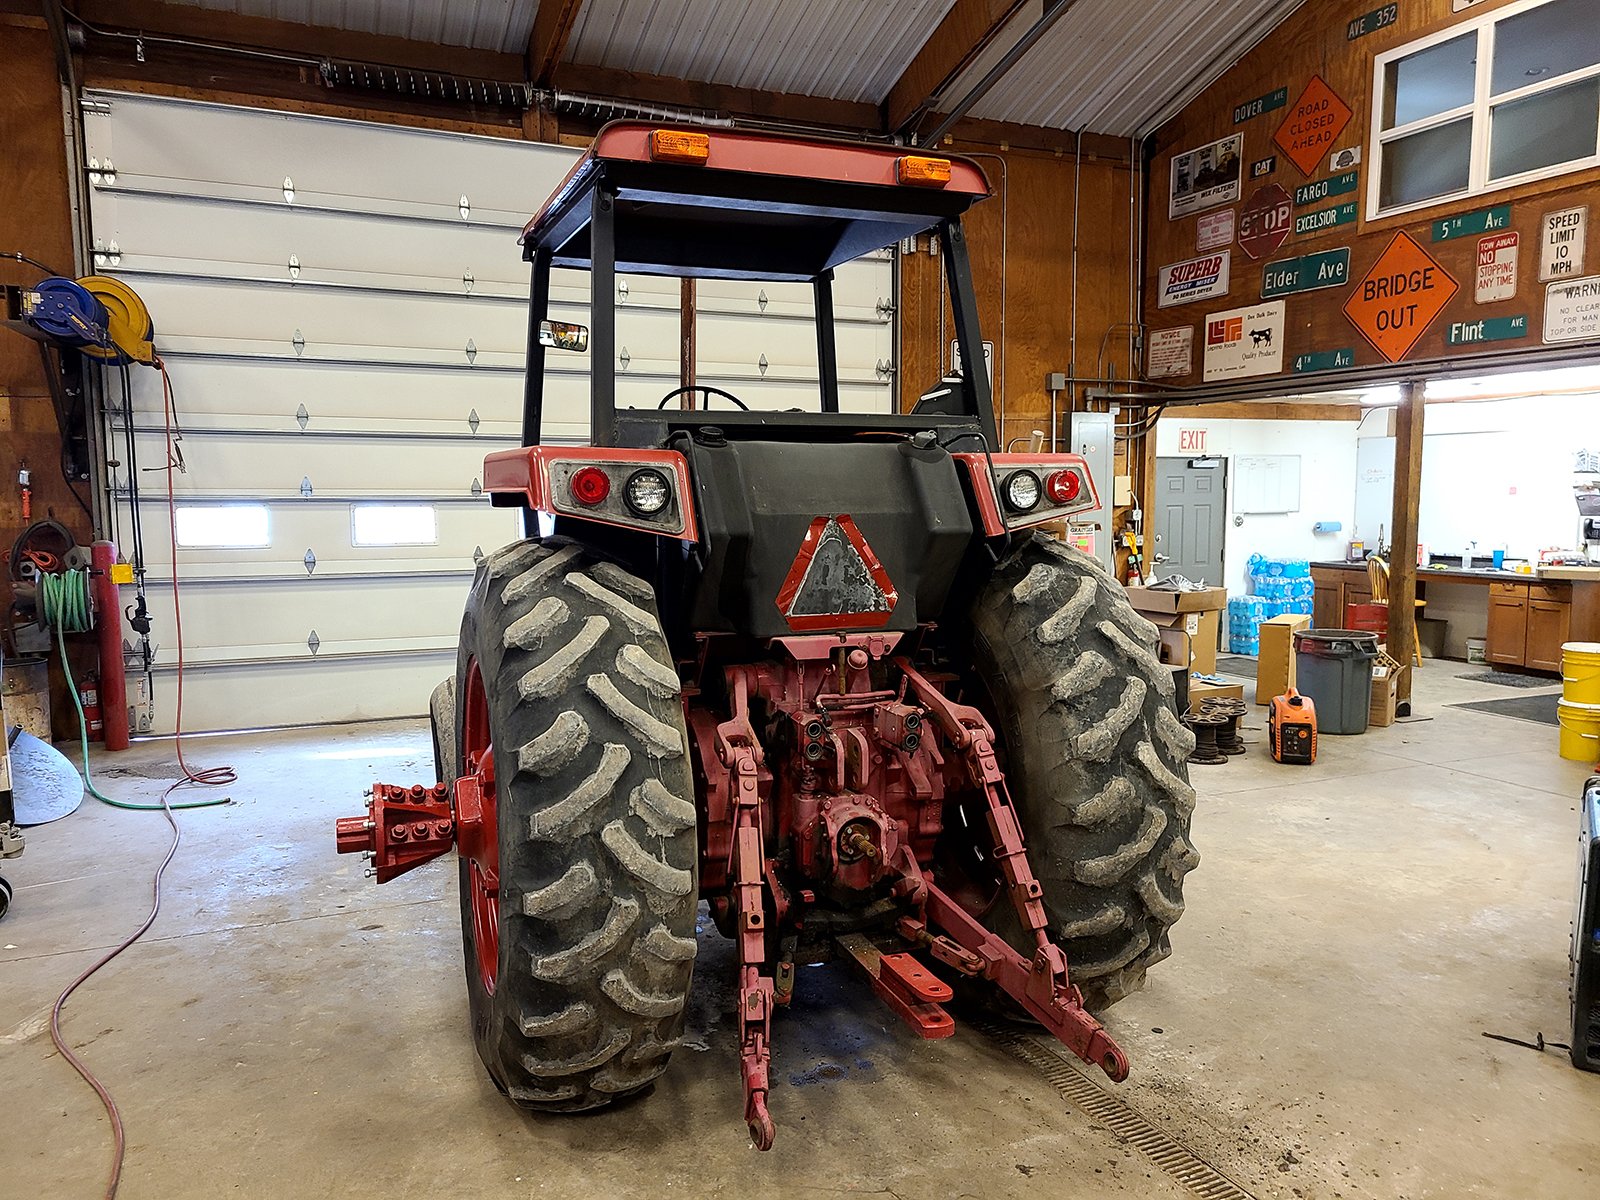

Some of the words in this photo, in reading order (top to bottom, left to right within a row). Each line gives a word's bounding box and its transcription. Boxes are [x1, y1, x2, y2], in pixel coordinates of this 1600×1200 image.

[1348, 18, 1365, 38] AVE
[1376, 5, 1396, 27] 352
[1235, 100, 1263, 123] DOVER
[1274, 90, 1284, 101] AVE
[1298, 99, 1329, 118] ROAD
[1290, 113, 1335, 136] CLOSED
[1291, 130, 1332, 151] AHEAD
[1254, 158, 1273, 176] CAT
[1212, 182, 1236, 195] FILTERS
[1296, 181, 1328, 203] FARGO
[1341, 174, 1354, 185] AVE
[1296, 209, 1337, 233] EXCELSIOR
[1342, 204, 1354, 215] AVE
[1549, 212, 1580, 230] SPEED
[1480, 240, 1494, 250] TOW
[1495, 236, 1516, 248] AWAY
[1550, 228, 1577, 244] LIMIT
[1479, 251, 1494, 265] NO
[1556, 245, 1569, 260] 10
[1168, 256, 1223, 286] SUPERB
[1264, 270, 1299, 290] Elder
[1318, 262, 1344, 281] Ave
[1480, 261, 1514, 278] STOPPING
[1550, 260, 1572, 275] MPH
[1168, 282, 1192, 293] ENERGY
[1195, 277, 1216, 287] MISER
[1363, 267, 1435, 302] BRIDGE
[1478, 278, 1494, 290] ANY
[1496, 274, 1513, 286] TIME
[1180, 290, 1196, 299] SERIES
[1196, 286, 1213, 295] DRYER
[1376, 304, 1418, 332] OUT
[1560, 307, 1570, 315] NO
[1563, 316, 1577, 324] FOR
[1582, 314, 1598, 322] MAN
[1451, 320, 1485, 343] Flint
[1510, 317, 1524, 328] AVE
[1551, 328, 1565, 336] TOP
[1567, 326, 1577, 334] OR
[1580, 323, 1597, 333] SIDE
[1241, 351, 1257, 361] Quality
[1295, 355, 1311, 371] 4TH
[1180, 430, 1207, 450] EXIT
